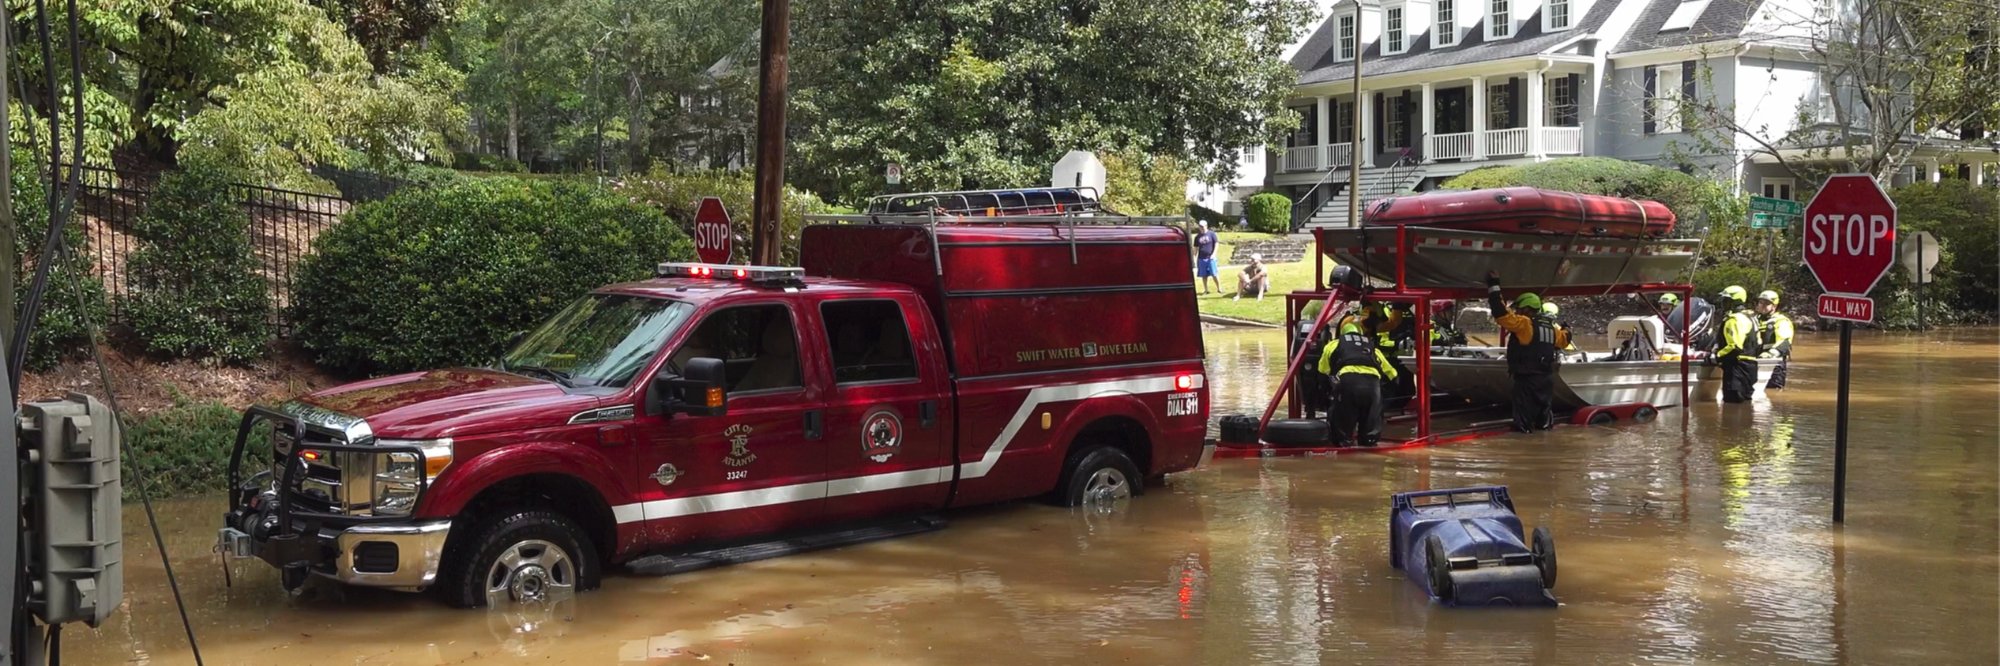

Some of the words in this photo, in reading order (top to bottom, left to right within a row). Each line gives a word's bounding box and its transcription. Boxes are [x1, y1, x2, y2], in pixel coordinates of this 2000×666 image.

[697, 222, 729, 250] STOP
[1809, 213, 1889, 256] STOP
[1822, 299, 1841, 315] ALL
[1846, 301, 1867, 317] WAY
[1016, 349, 1046, 362] SWIFT
[1047, 347, 1081, 360] WATER
[1099, 344, 1121, 356] DIVE
[1122, 342, 1148, 354] TEAM
[1167, 399, 1186, 417] DIAL
[1186, 397, 1199, 415] 911
[724, 423, 741, 437] CITY
[742, 424, 753, 434] OF
[721, 453, 758, 467] ATLANTA
[726, 470, 748, 480] 33247
